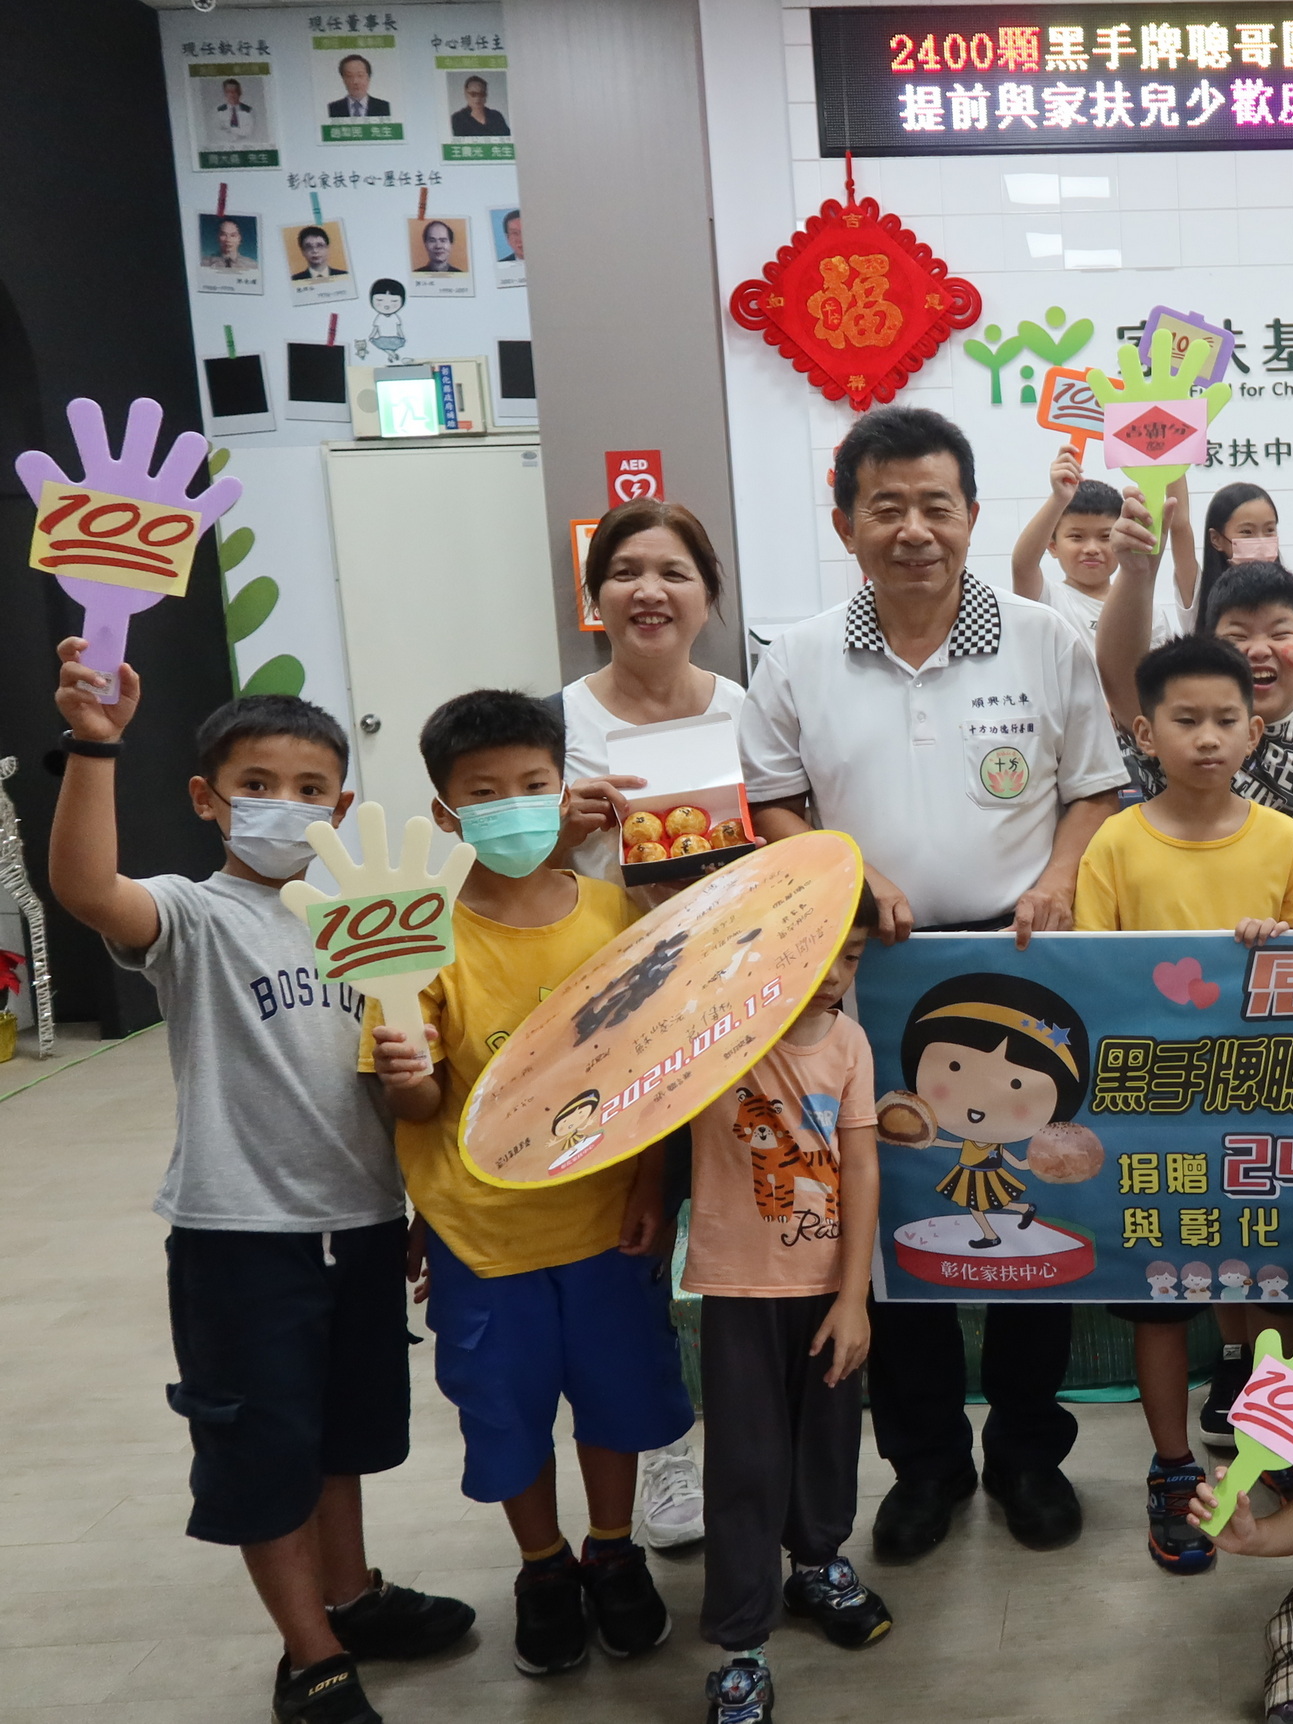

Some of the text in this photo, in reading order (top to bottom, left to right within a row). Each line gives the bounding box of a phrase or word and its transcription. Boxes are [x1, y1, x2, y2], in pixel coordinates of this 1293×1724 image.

[308, 13, 398, 32] 現任董事長
[182, 39, 271, 57] 現任執行長
[842, 213, 862, 229] 吉
[806, 254, 904, 349] 福
[1240, 383, 1265, 396] for
[620, 459, 648, 471] AED
[38, 494, 195, 547] 100
[971, 692, 1030, 708] 順興汽車
[315, 892, 445, 951] 100
[600, 975, 783, 1126] 2024.08.15
[1118, 1151, 1208, 1195] 捐贈
[939, 1257, 1058, 1283] 彰化家扶中心
[308, 1671, 349, 1697] LOTTO
